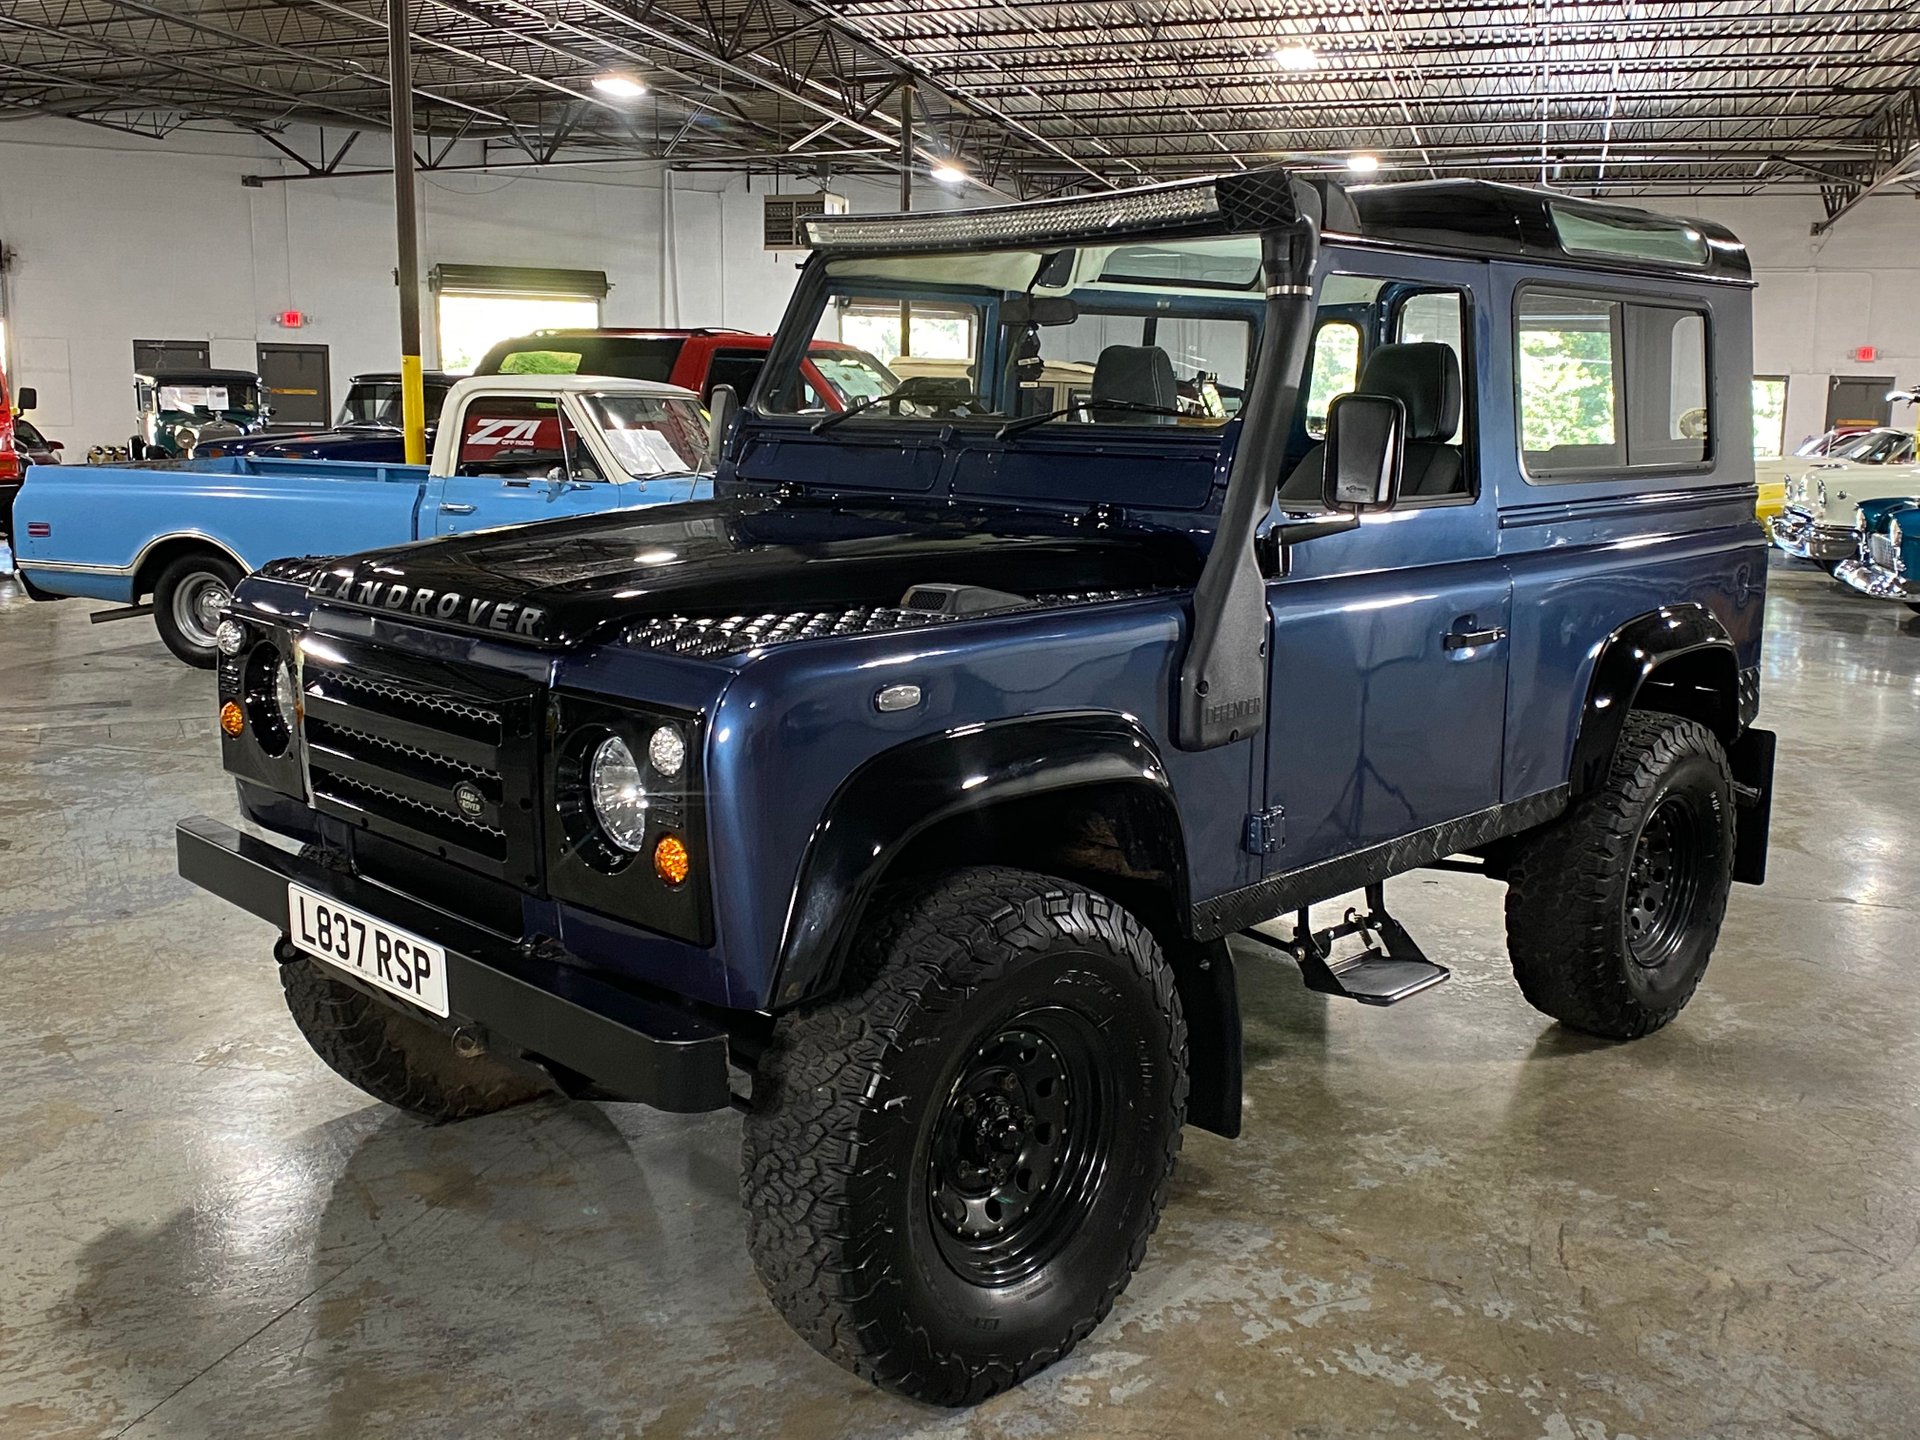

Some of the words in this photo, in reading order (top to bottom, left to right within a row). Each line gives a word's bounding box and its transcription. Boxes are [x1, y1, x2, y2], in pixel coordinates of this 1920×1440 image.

[1205, 696, 1261, 725] DEFENDER
[300, 896, 366, 968] L837
[375, 929, 431, 995] RSP
